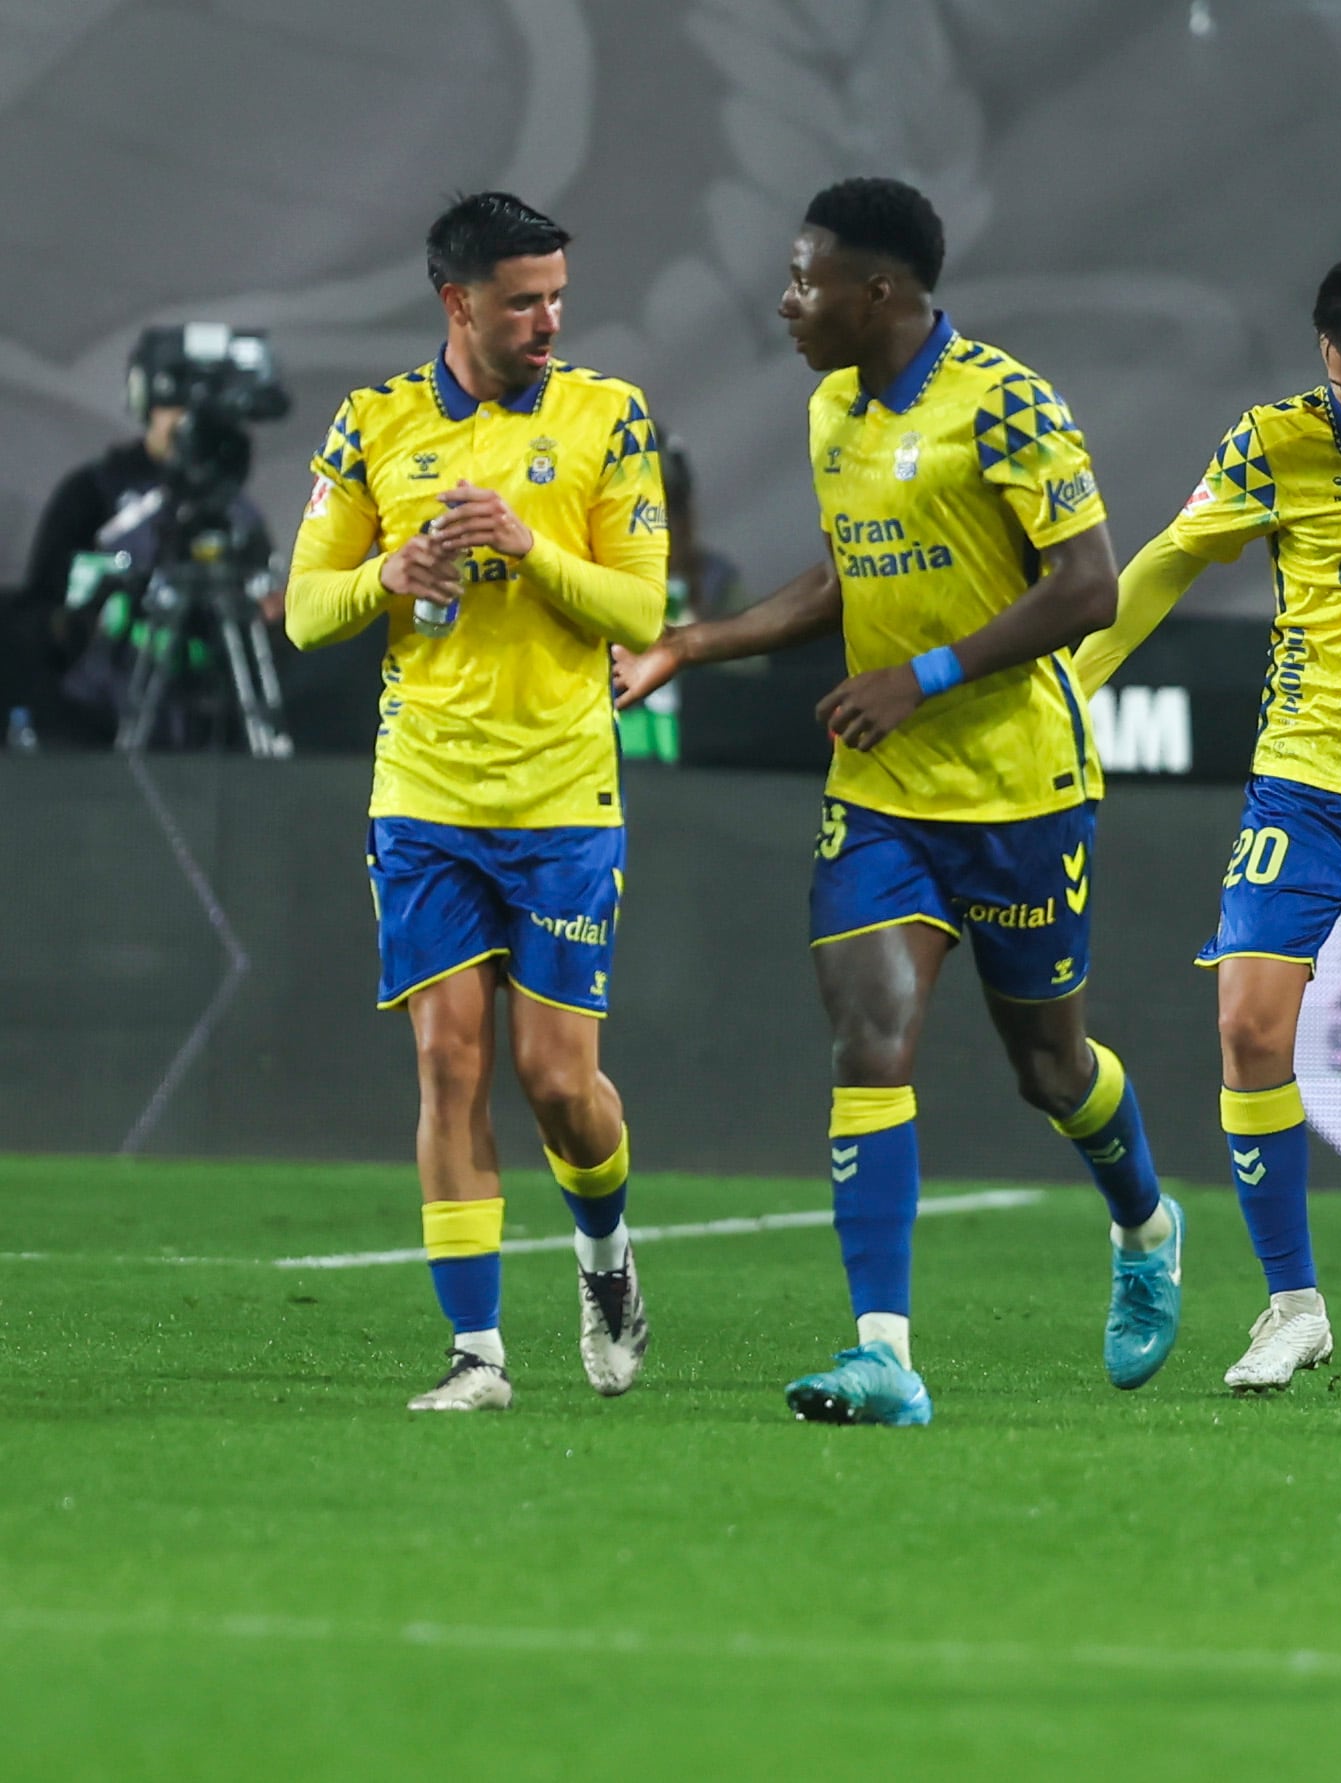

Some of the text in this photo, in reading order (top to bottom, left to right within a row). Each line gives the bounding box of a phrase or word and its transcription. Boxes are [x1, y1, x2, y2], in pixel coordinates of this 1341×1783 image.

[834, 513, 905, 544] Gran
[1222, 826, 1290, 890] 20
[967, 897, 1056, 929] ordial
